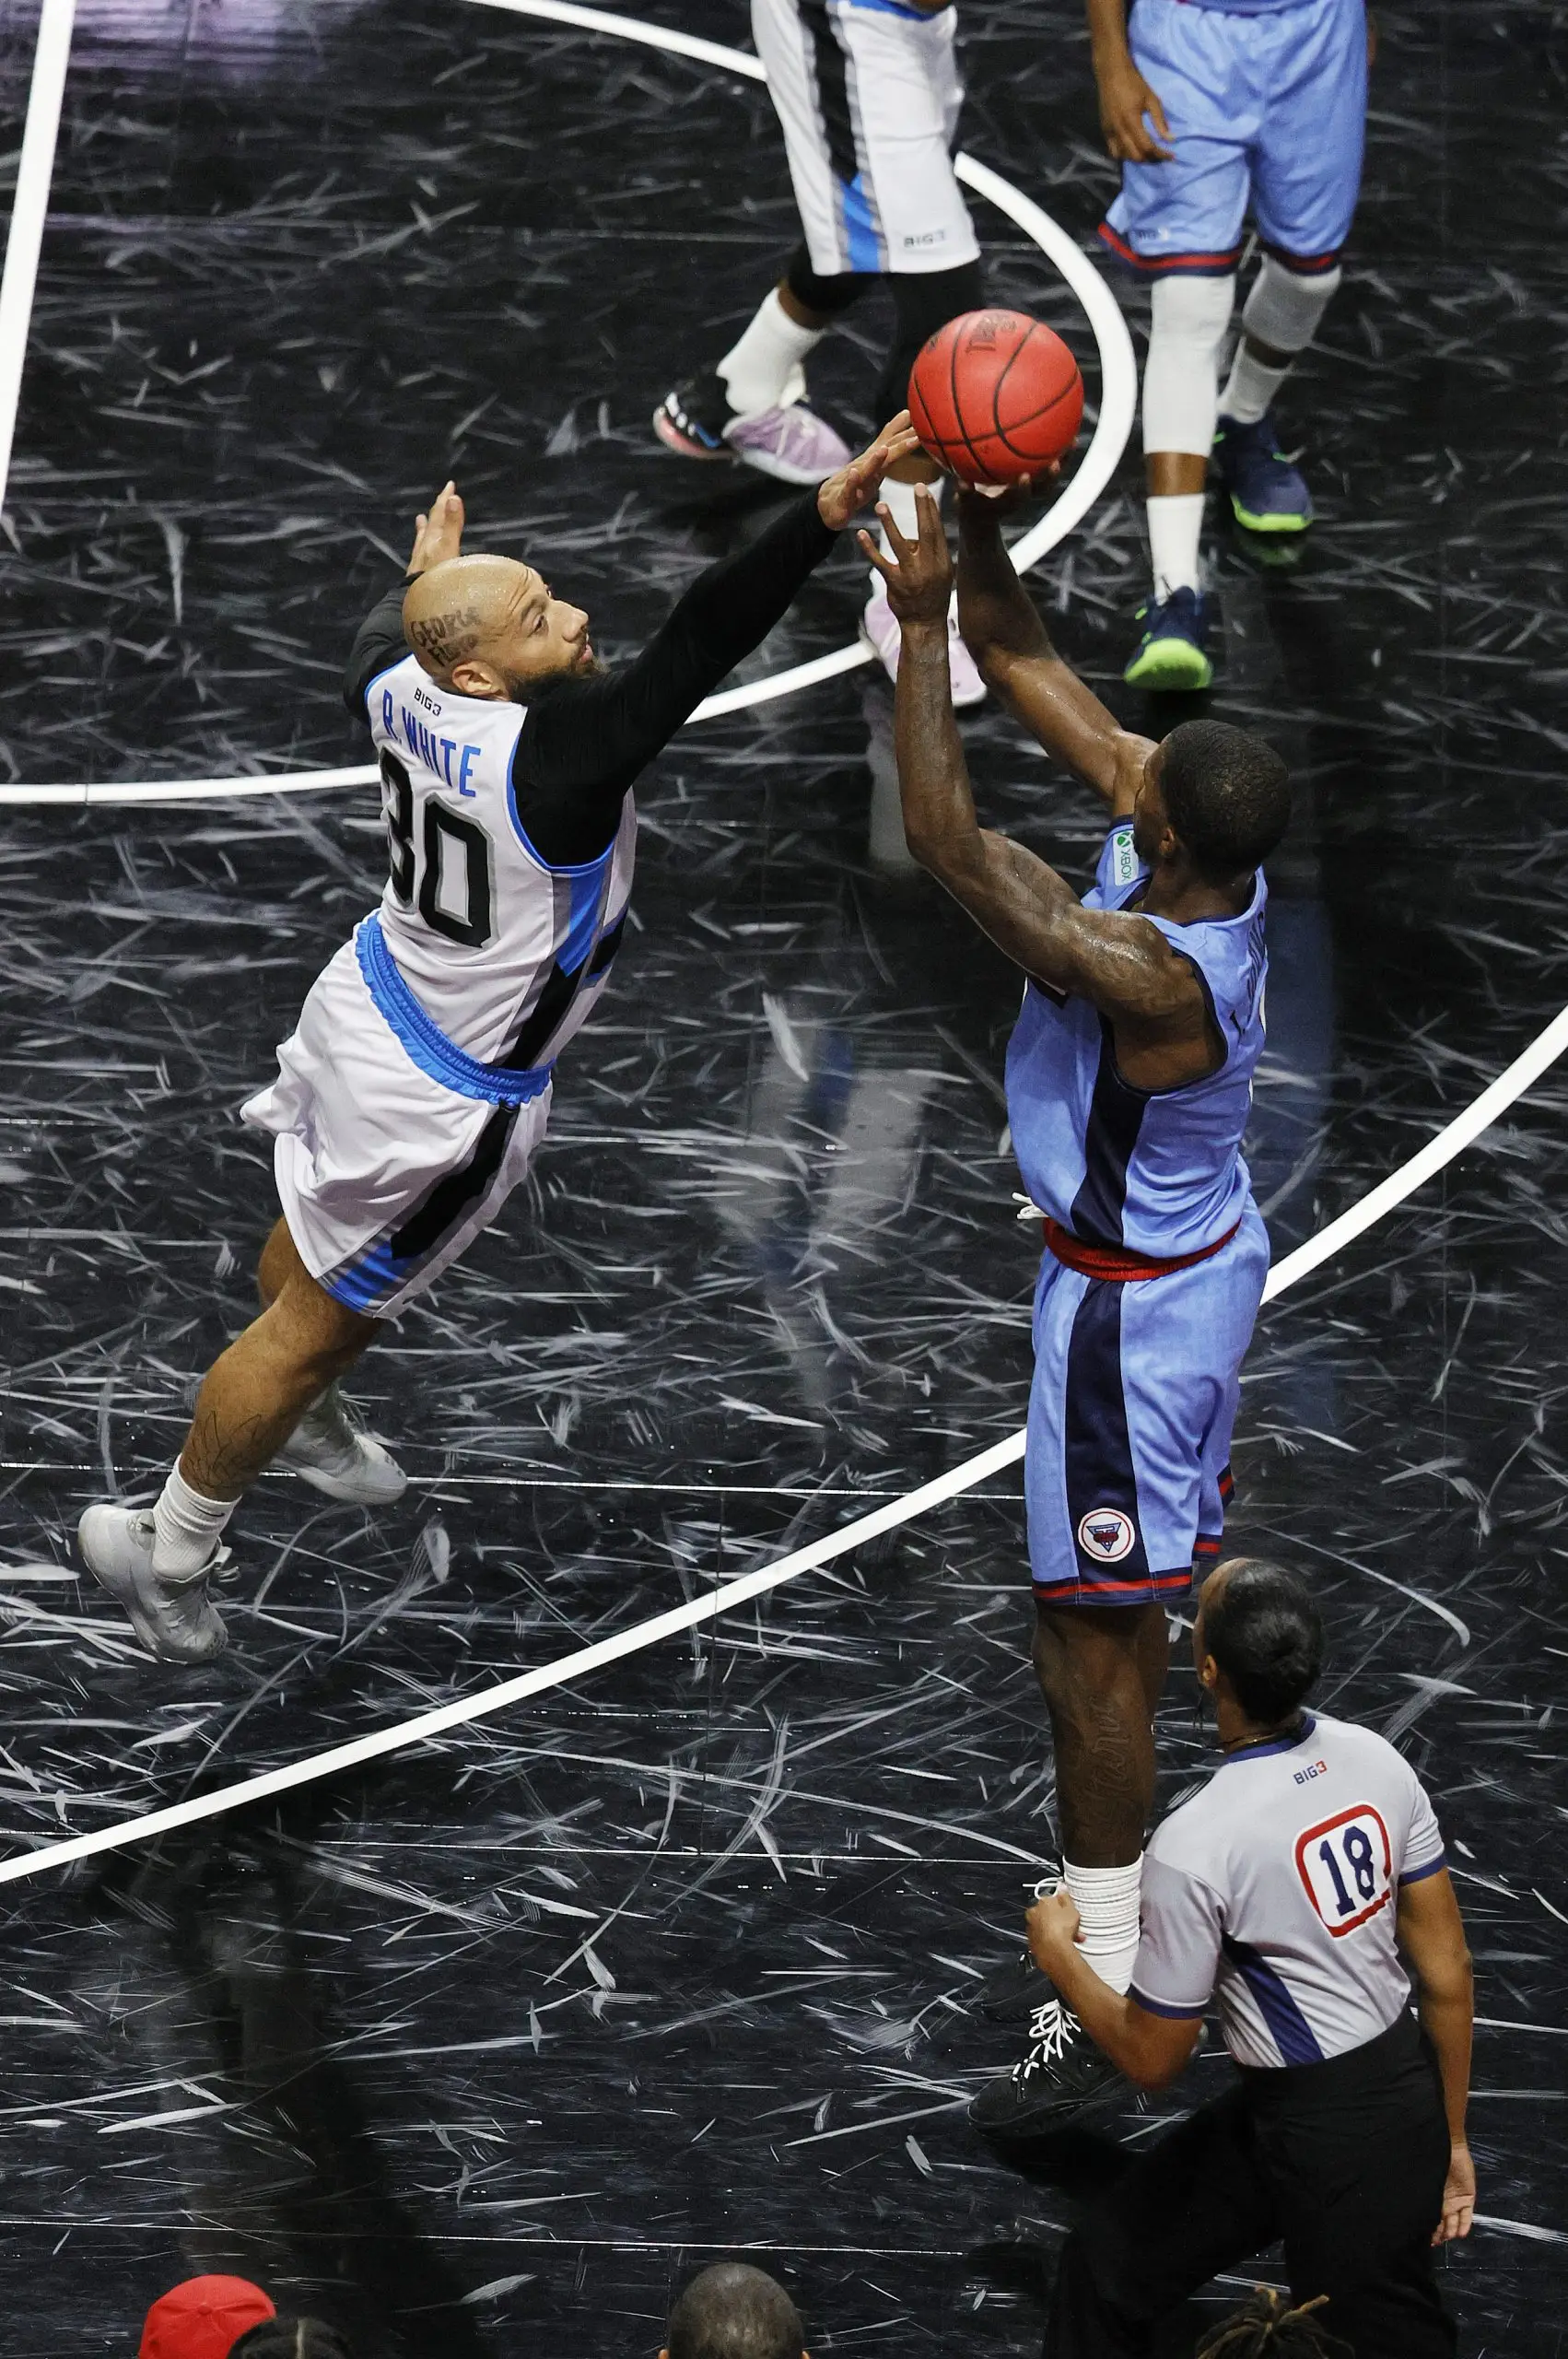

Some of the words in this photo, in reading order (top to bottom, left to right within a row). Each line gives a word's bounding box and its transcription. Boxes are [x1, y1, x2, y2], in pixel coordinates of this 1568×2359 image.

[414, 687, 442, 717] BIG3
[379, 745, 497, 949] 30
[1120, 849, 1132, 881] XBOX
[1293, 1761, 1327, 1785] BIG3
[1319, 1825, 1375, 1917] 18
